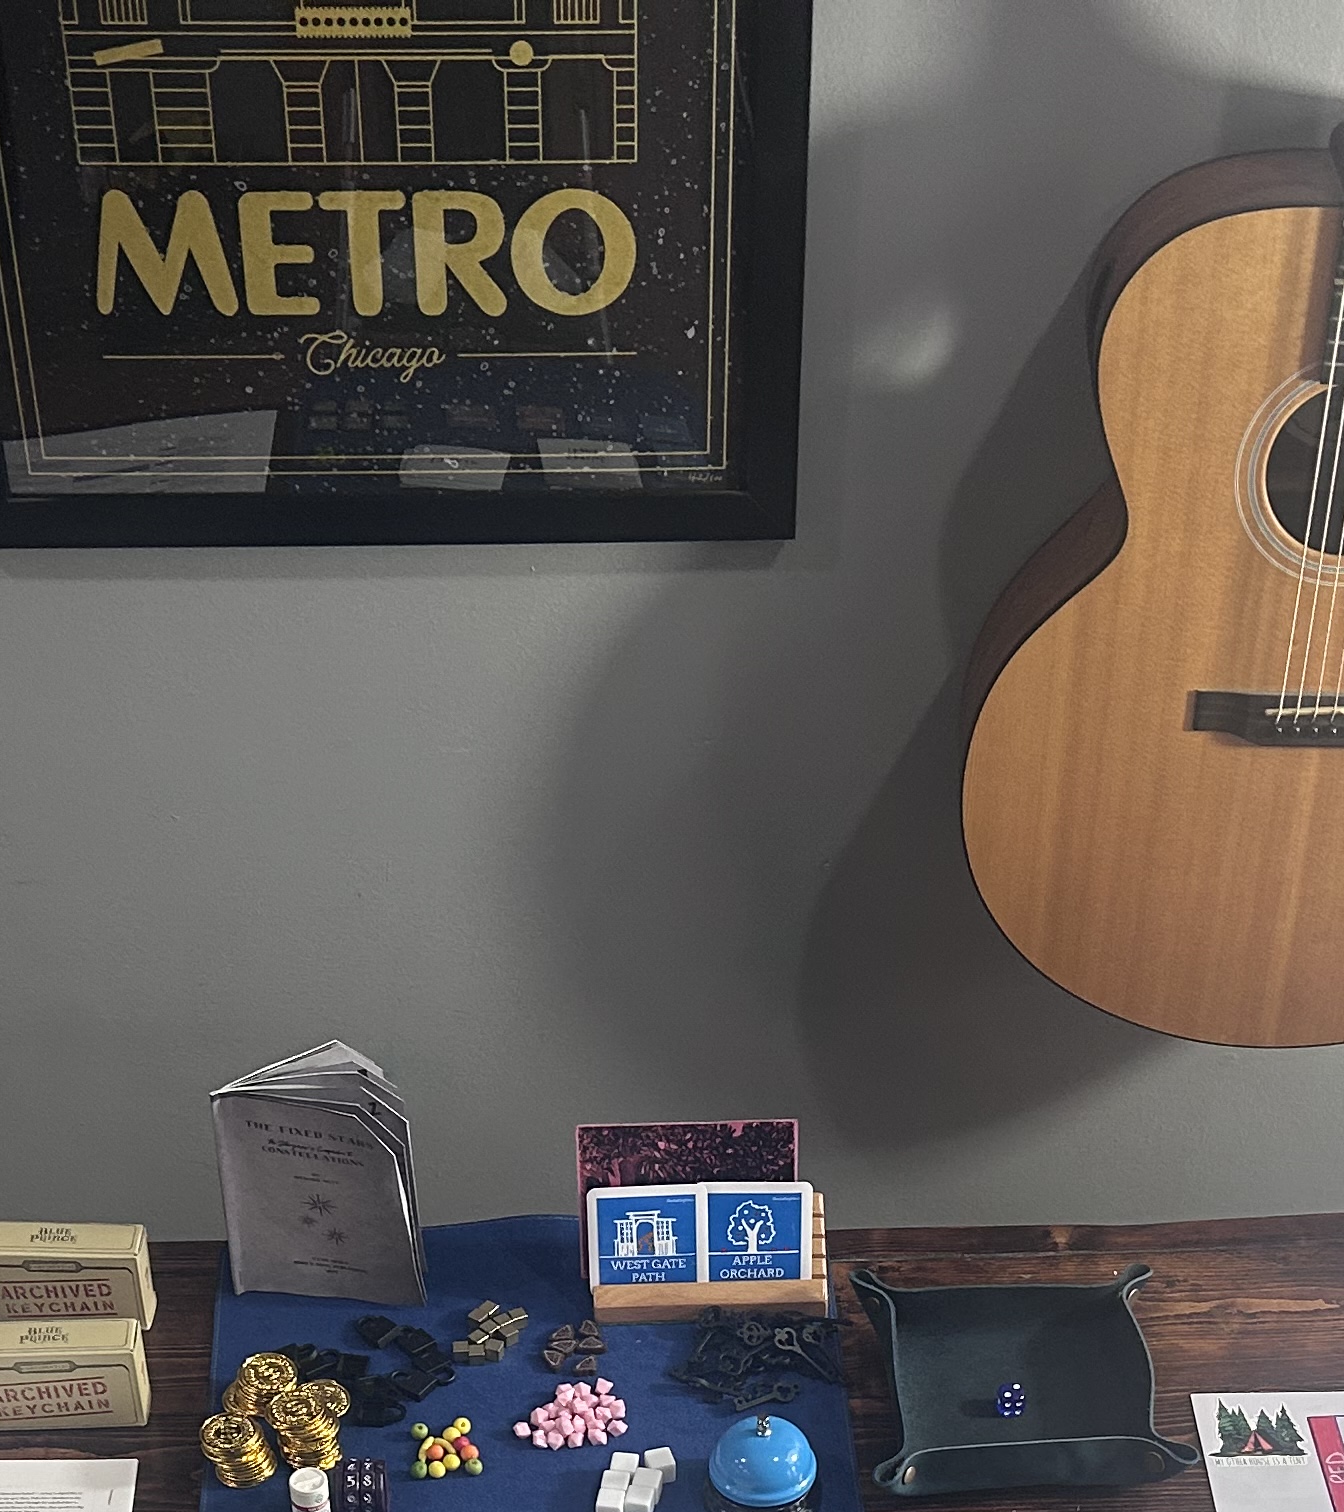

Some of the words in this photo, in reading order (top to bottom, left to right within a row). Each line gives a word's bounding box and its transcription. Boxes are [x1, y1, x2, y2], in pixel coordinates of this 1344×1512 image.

[95, 187, 638, 317] METRO
[297, 331, 446, 382] Chicago
[38, 1226, 72, 1236] BLUE
[611, 1259, 650, 1271] WEST
[652, 1258, 687, 1270] GATE
[732, 1254, 773, 1267] APPLE
[632, 1272, 666, 1283] PATH
[719, 1268, 785, 1280] ORCHARD
[0, 1282, 113, 1301] ARCHIVED
[5, 1300, 116, 1314] KEYCHAIN
[27, 1326, 63, 1335] BLUE
[346, 1475, 356, 1488] 5
[362, 1474, 372, 1487] 8
